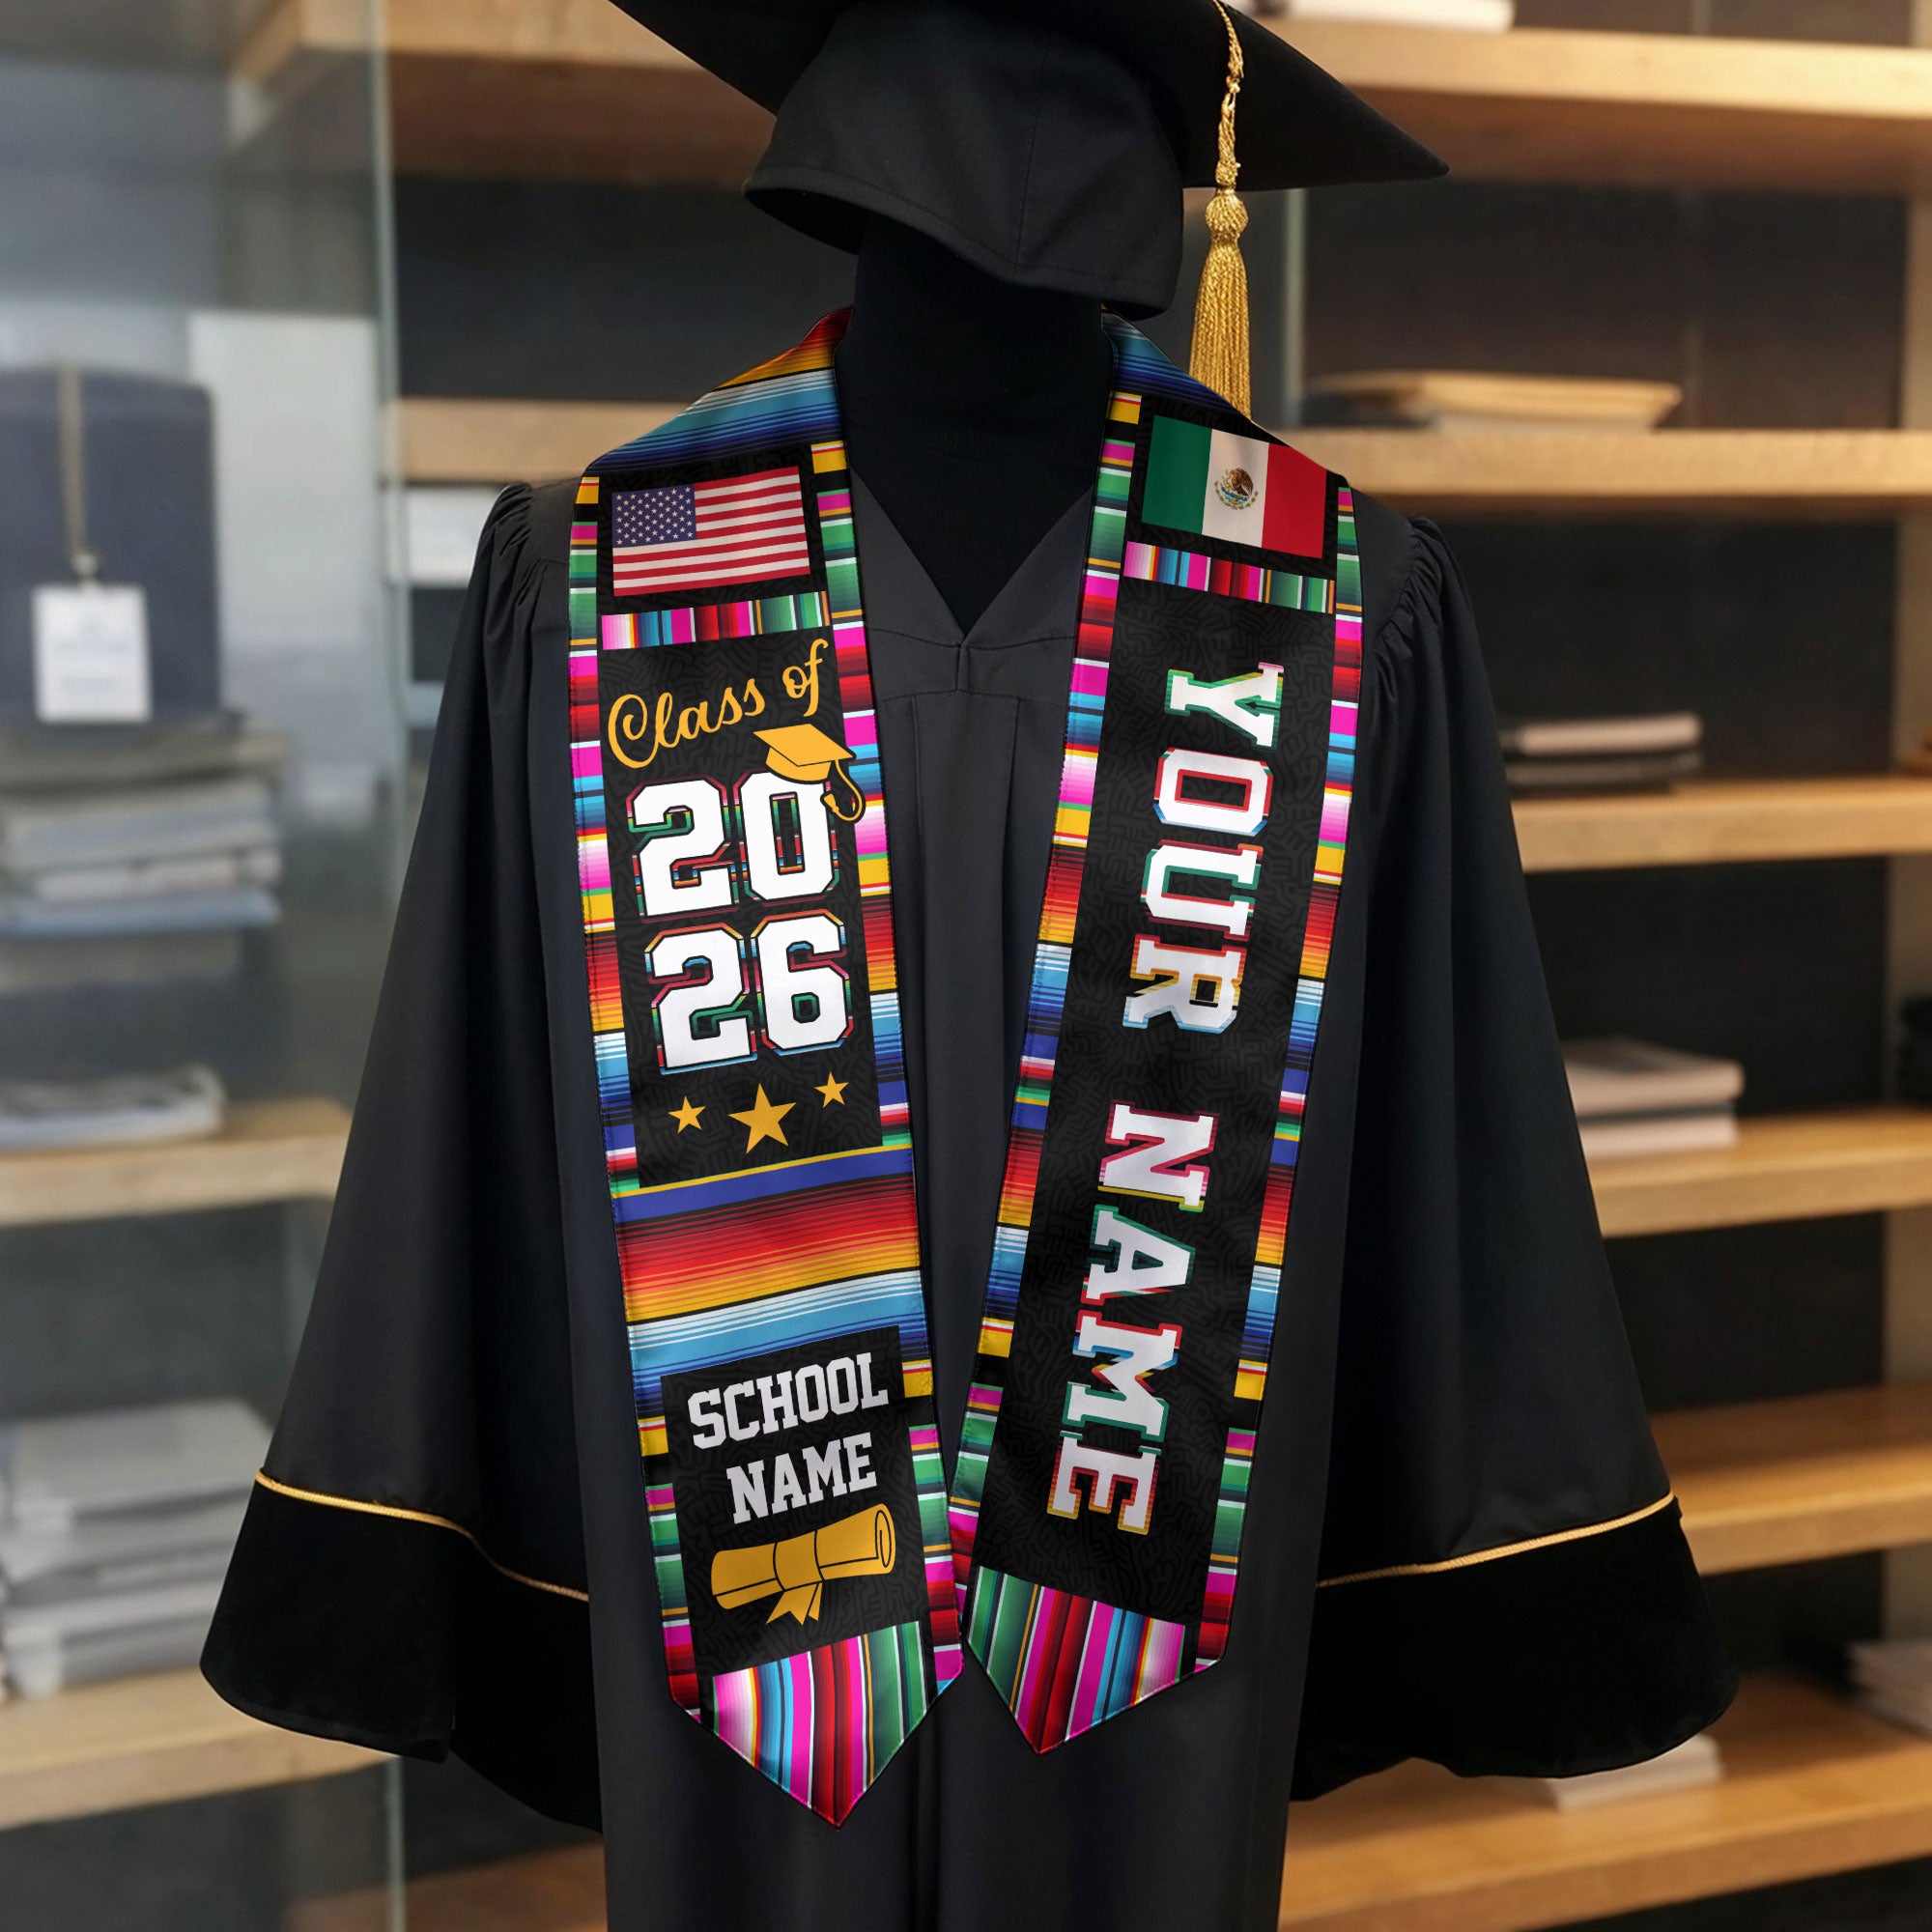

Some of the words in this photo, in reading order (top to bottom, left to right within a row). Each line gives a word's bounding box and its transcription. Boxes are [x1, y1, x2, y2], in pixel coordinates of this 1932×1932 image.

[608, 678, 765, 768] Class
[782, 638, 829, 717] of
[626, 768, 839, 923] 20
[1122, 662, 1285, 1035] YOUR
[644, 909, 854, 1075] 26
[1047, 1099, 1219, 1535] NAME
[687, 1351, 889, 1449] SCHOOL
[726, 1432, 877, 1524] NAME
